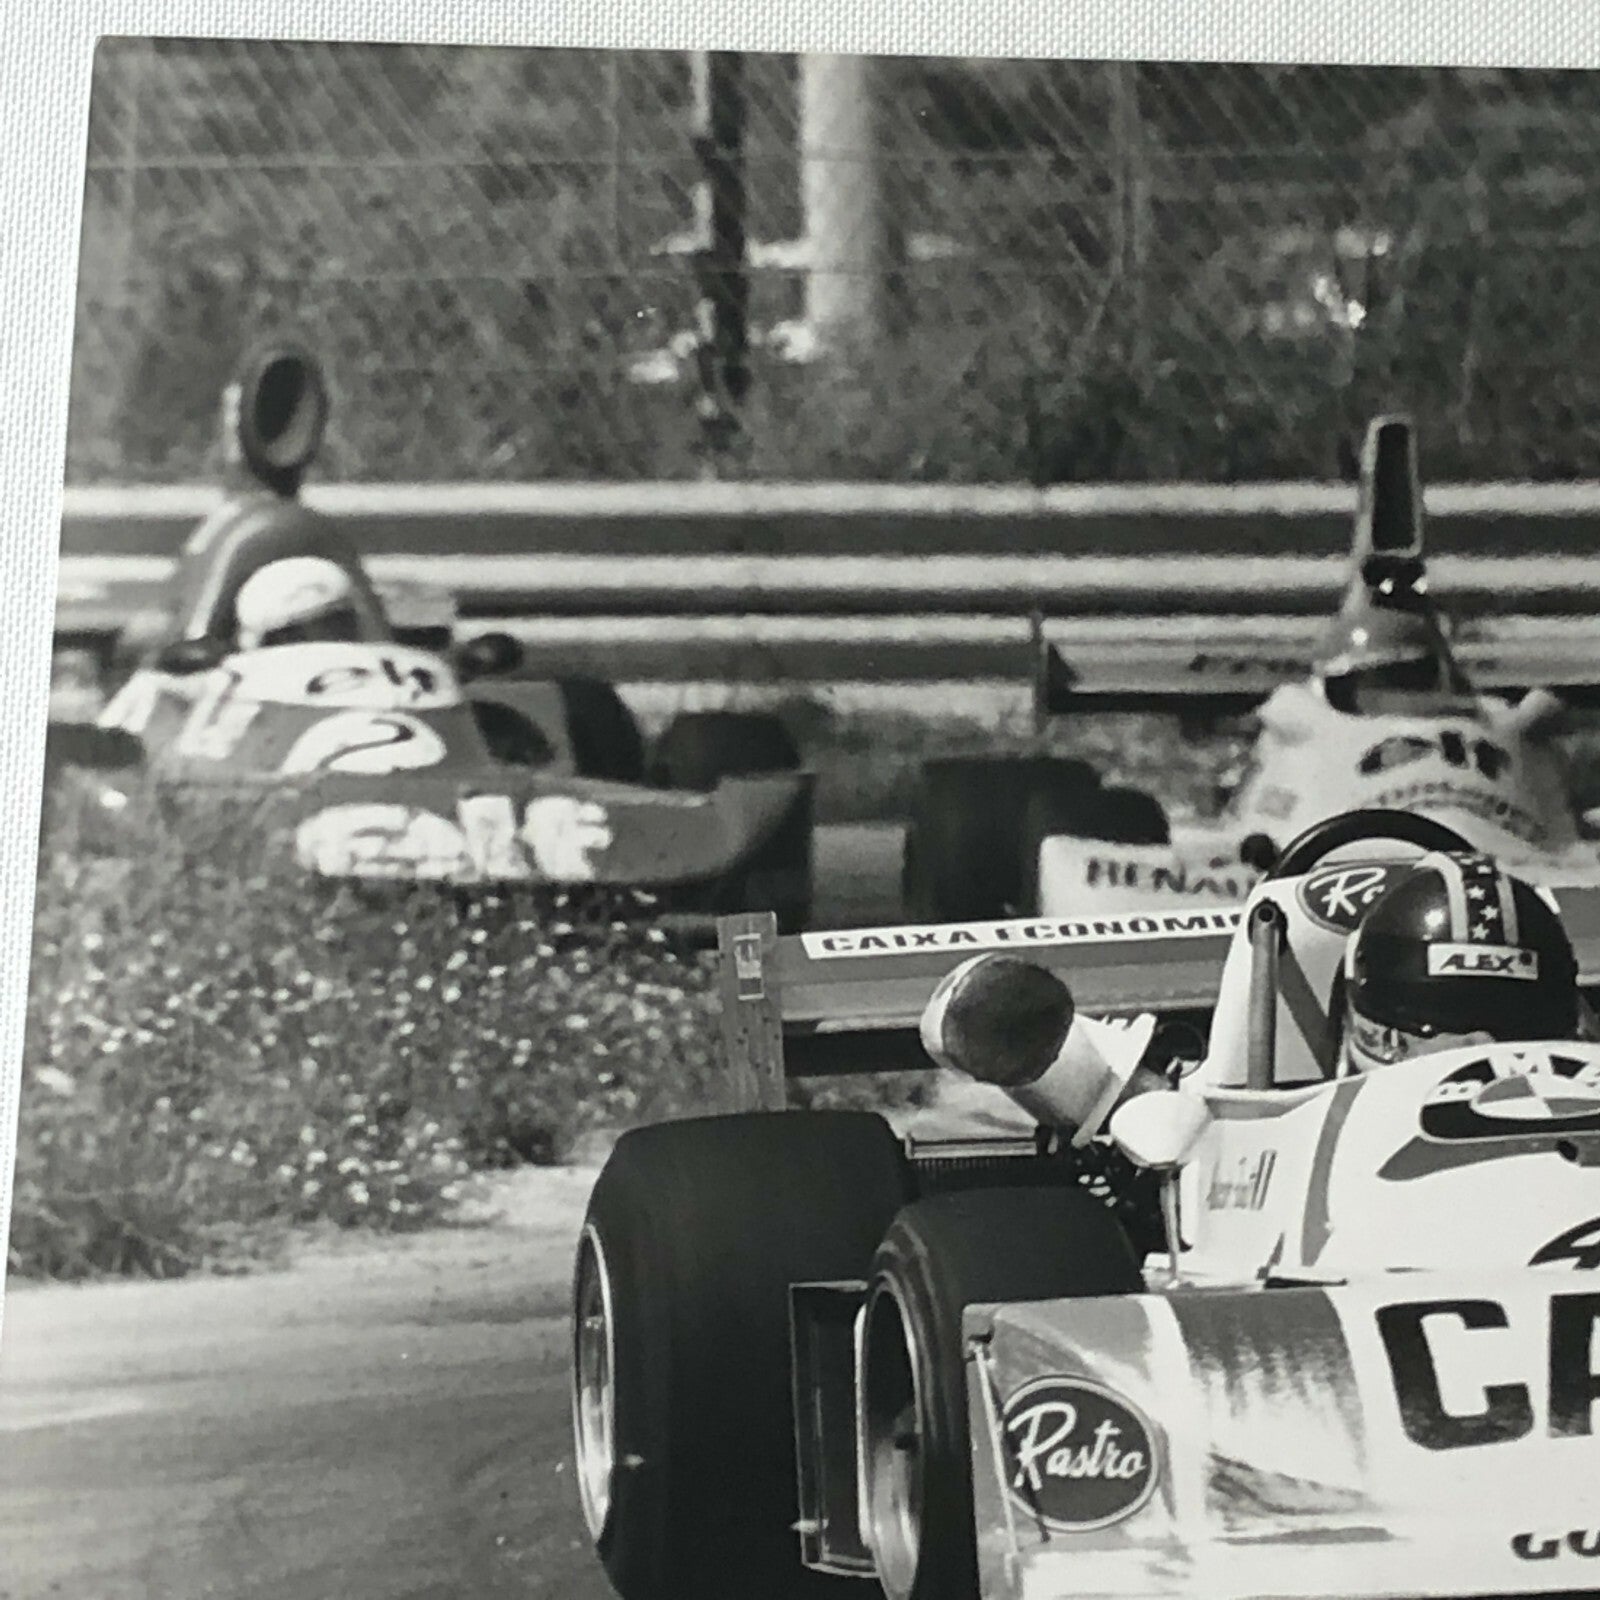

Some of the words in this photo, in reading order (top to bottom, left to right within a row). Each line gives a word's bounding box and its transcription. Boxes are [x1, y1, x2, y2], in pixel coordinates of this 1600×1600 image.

[822, 930, 977, 952] CAIXA
[1439, 953, 1516, 975] ALEX
[1008, 1401, 1147, 1491] Rastro
